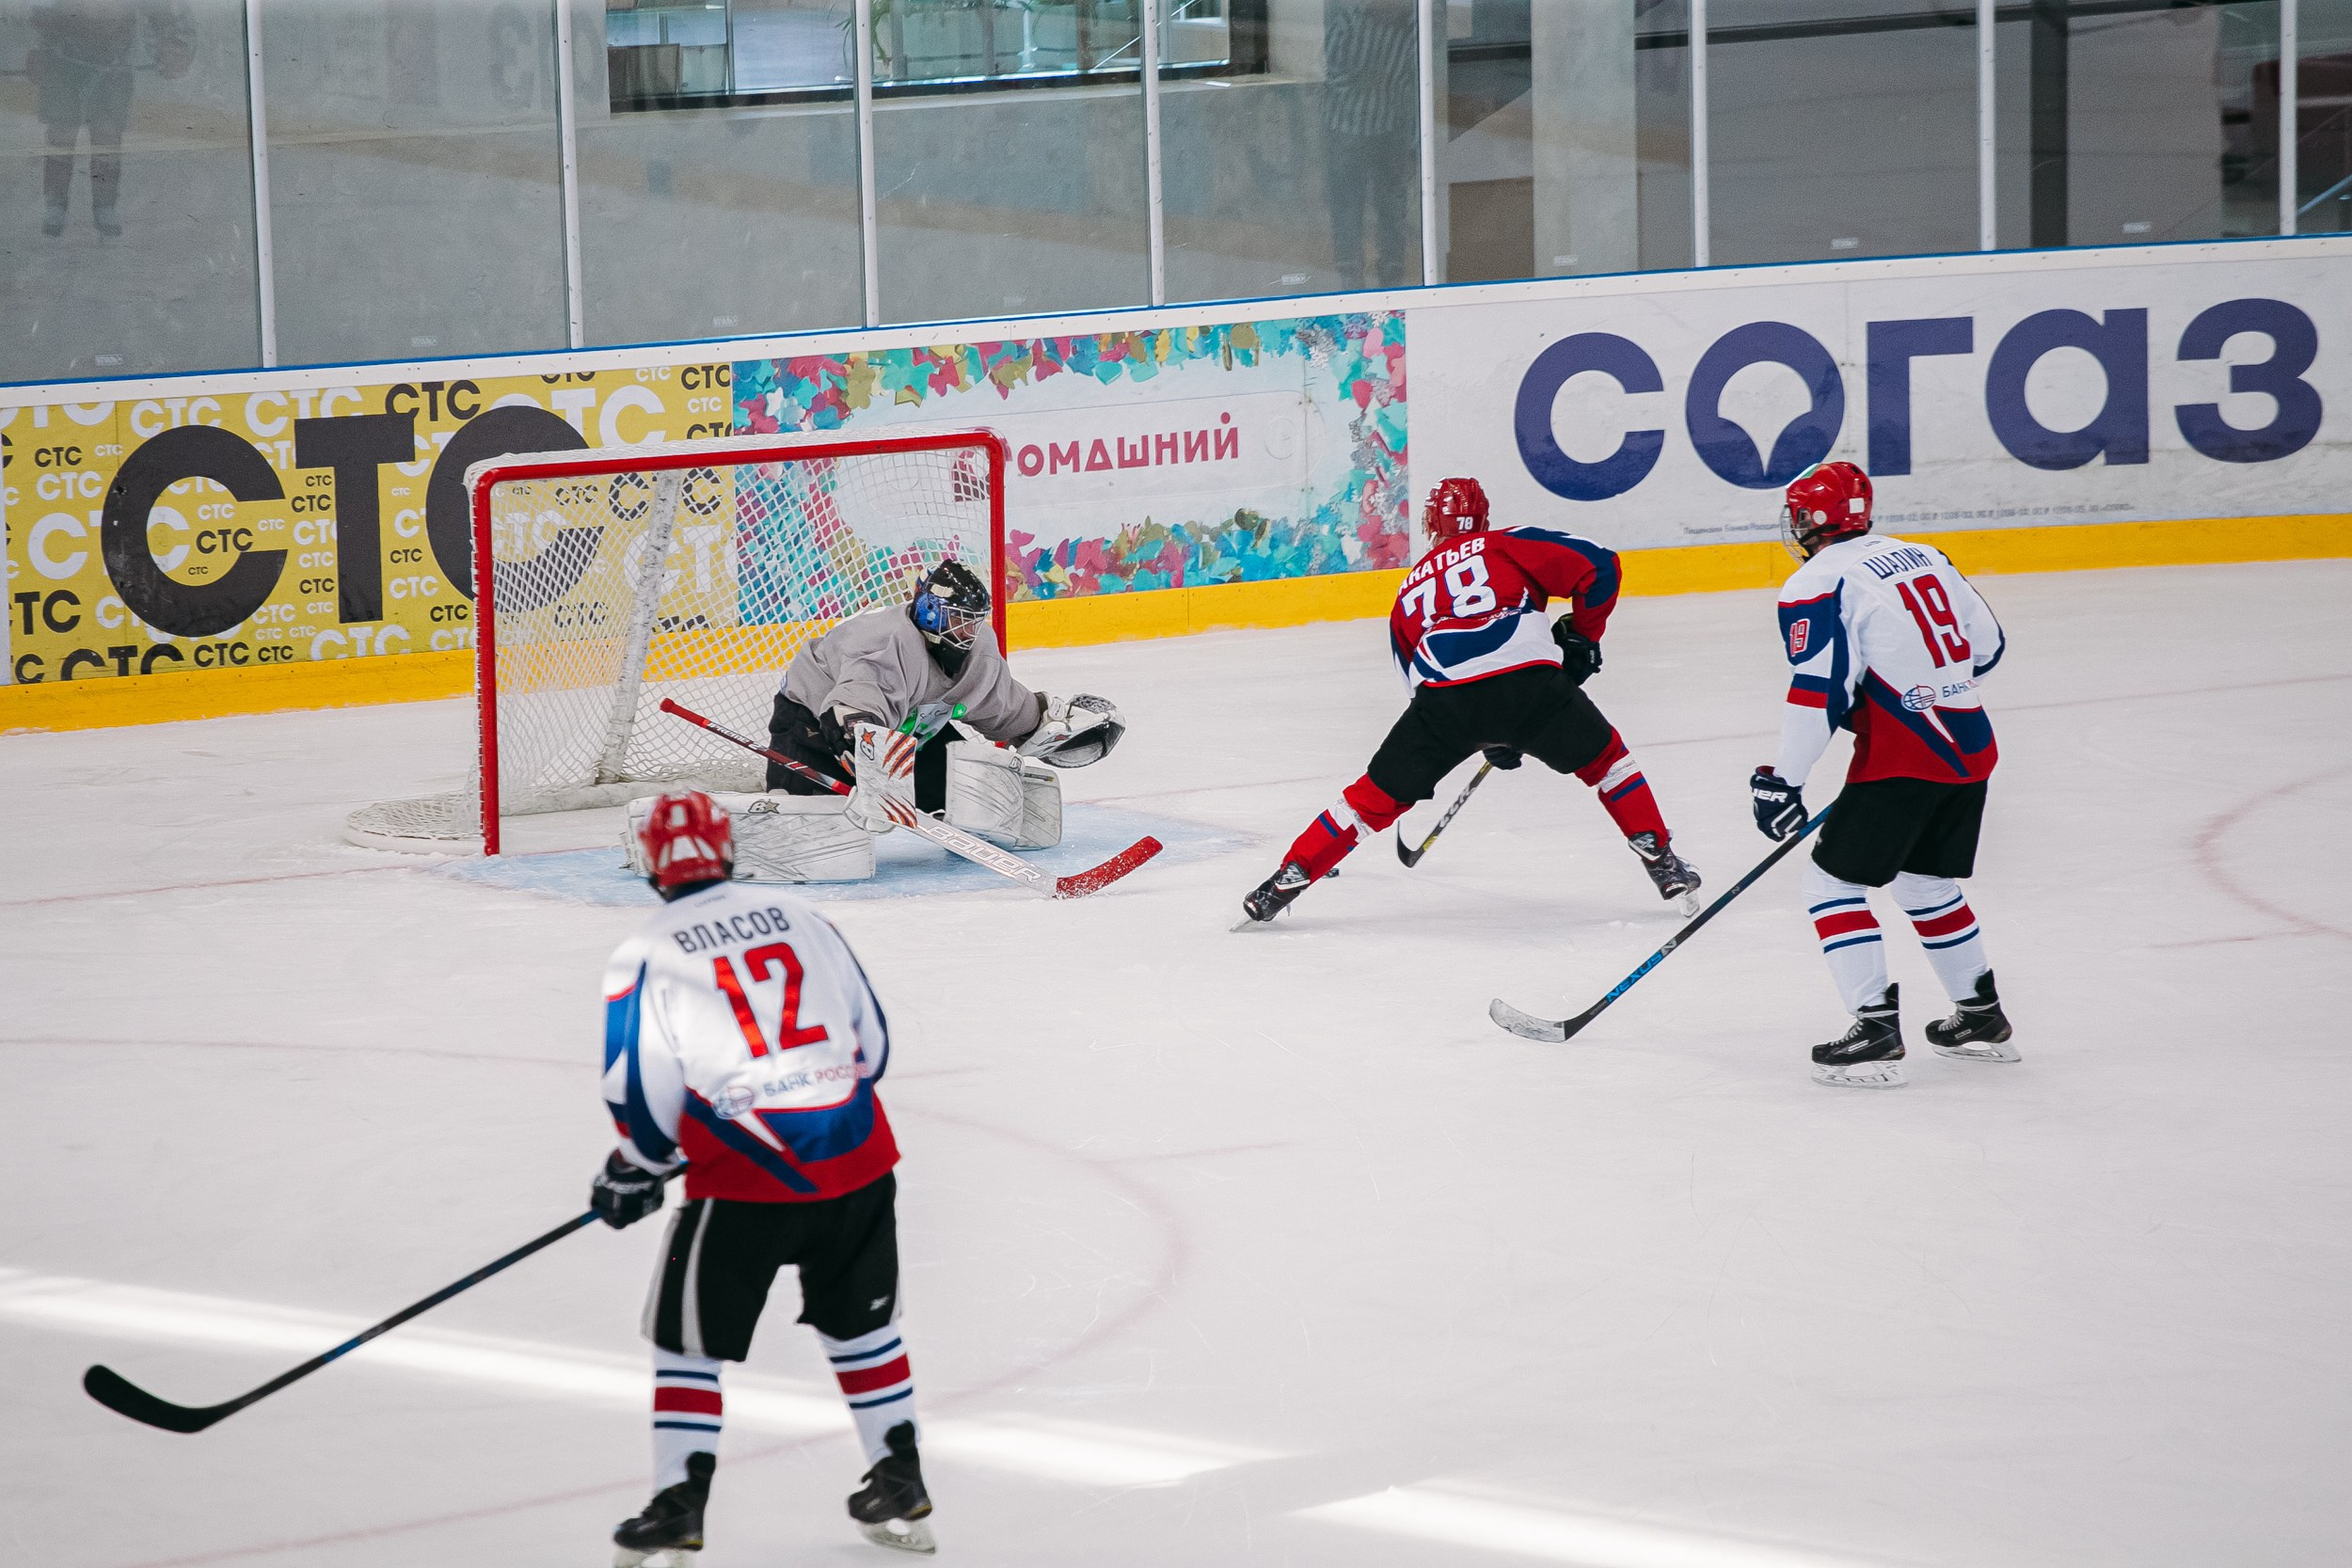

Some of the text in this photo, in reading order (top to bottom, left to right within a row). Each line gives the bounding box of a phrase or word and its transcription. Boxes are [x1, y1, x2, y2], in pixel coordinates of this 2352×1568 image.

[635, 366, 671, 383] СТС
[688, 397, 722, 414] СТС
[490, 385, 666, 449] ТС
[35, 446, 83, 467] СТС
[37, 470, 103, 500] СТС
[306, 475, 332, 487] СТС
[198, 503, 235, 520] СТС
[291, 494, 331, 513] СТС
[101, 405, 604, 637] СТС
[258, 519, 285, 531] СТС
[1456, 516, 1473, 531] 78
[196, 528, 253, 554] СТС
[298, 551, 334, 568] СТС
[389, 547, 422, 563] СТС
[1862, 547, 1932, 579] ШАЛИН
[188, 566, 208, 575] СТС
[299, 578, 334, 594] СТС
[389, 575, 438, 599] СТС
[1401, 555, 1497, 627] 78
[8, 589, 81, 635] ТС
[252, 604, 295, 625] СТС
[307, 602, 334, 614] СТС
[430, 604, 468, 622] СТС
[1895, 574, 1971, 669] 19
[194, 641, 249, 667] СТС
[258, 645, 294, 662] СТС
[674, 907, 789, 953] ВЛАСОВ
[1607, 953, 1663, 1003] NEXUS
[713, 942, 828, 1057] 12
[763, 1072, 812, 1097] БАНК
